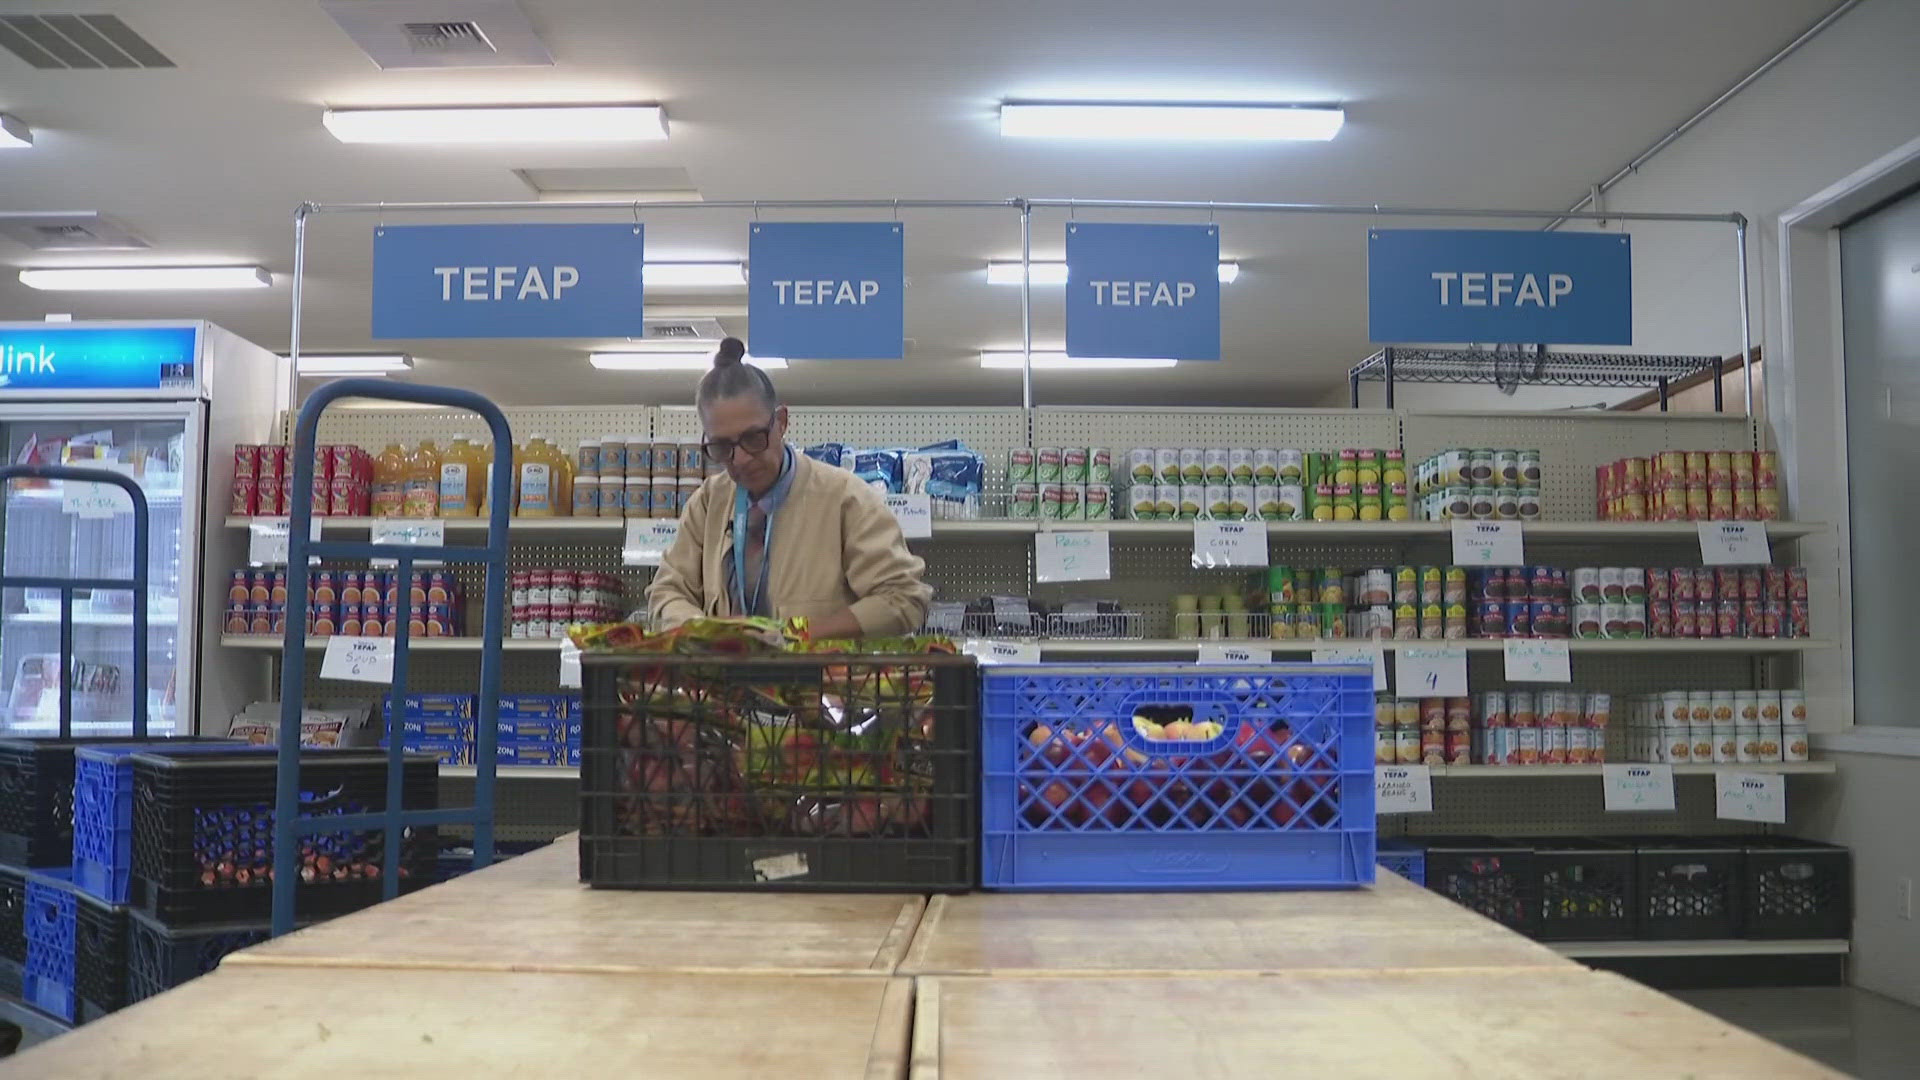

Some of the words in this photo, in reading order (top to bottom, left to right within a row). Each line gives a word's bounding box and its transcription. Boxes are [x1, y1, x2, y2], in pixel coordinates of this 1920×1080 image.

[434, 266, 579, 301] TEFAP
[1431, 272, 1574, 307] TEFAP
[772, 280, 879, 305] TEFAP
[1090, 281, 1196, 307] TEFAP
[1210, 539, 1238, 547] CORN
[1063, 555, 1077, 571] 2
[993, 647, 1018, 655] TEFAP
[1225, 652, 1249, 660] TEFAP
[351, 664, 361, 675] 6
[1426, 672, 1437, 690] 4
[1741, 781, 1764, 789] TEFAP
[1408, 791, 1417, 802] 3
